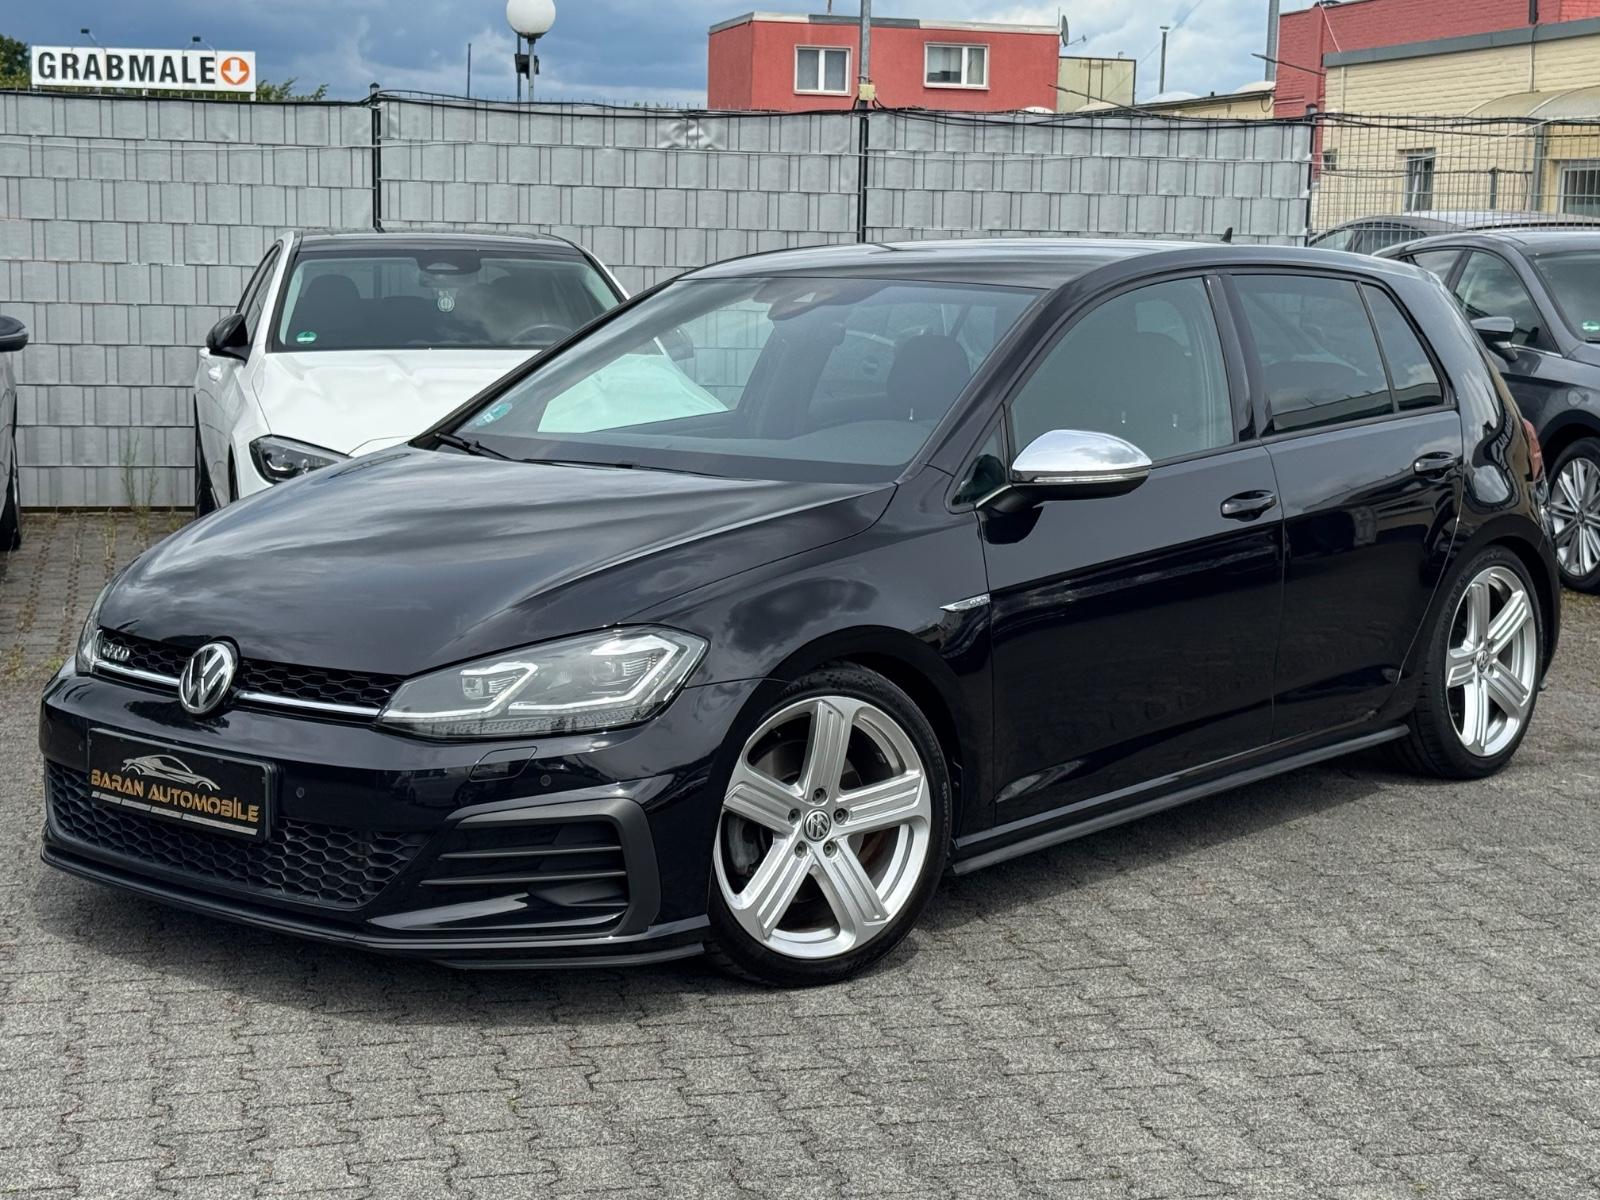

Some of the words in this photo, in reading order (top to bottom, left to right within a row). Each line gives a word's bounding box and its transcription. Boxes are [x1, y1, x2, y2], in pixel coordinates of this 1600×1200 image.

[38, 52, 216, 84] GRABMALE
[91, 769, 144, 797] BARAN
[149, 784, 260, 822] AUTOMOBILE
